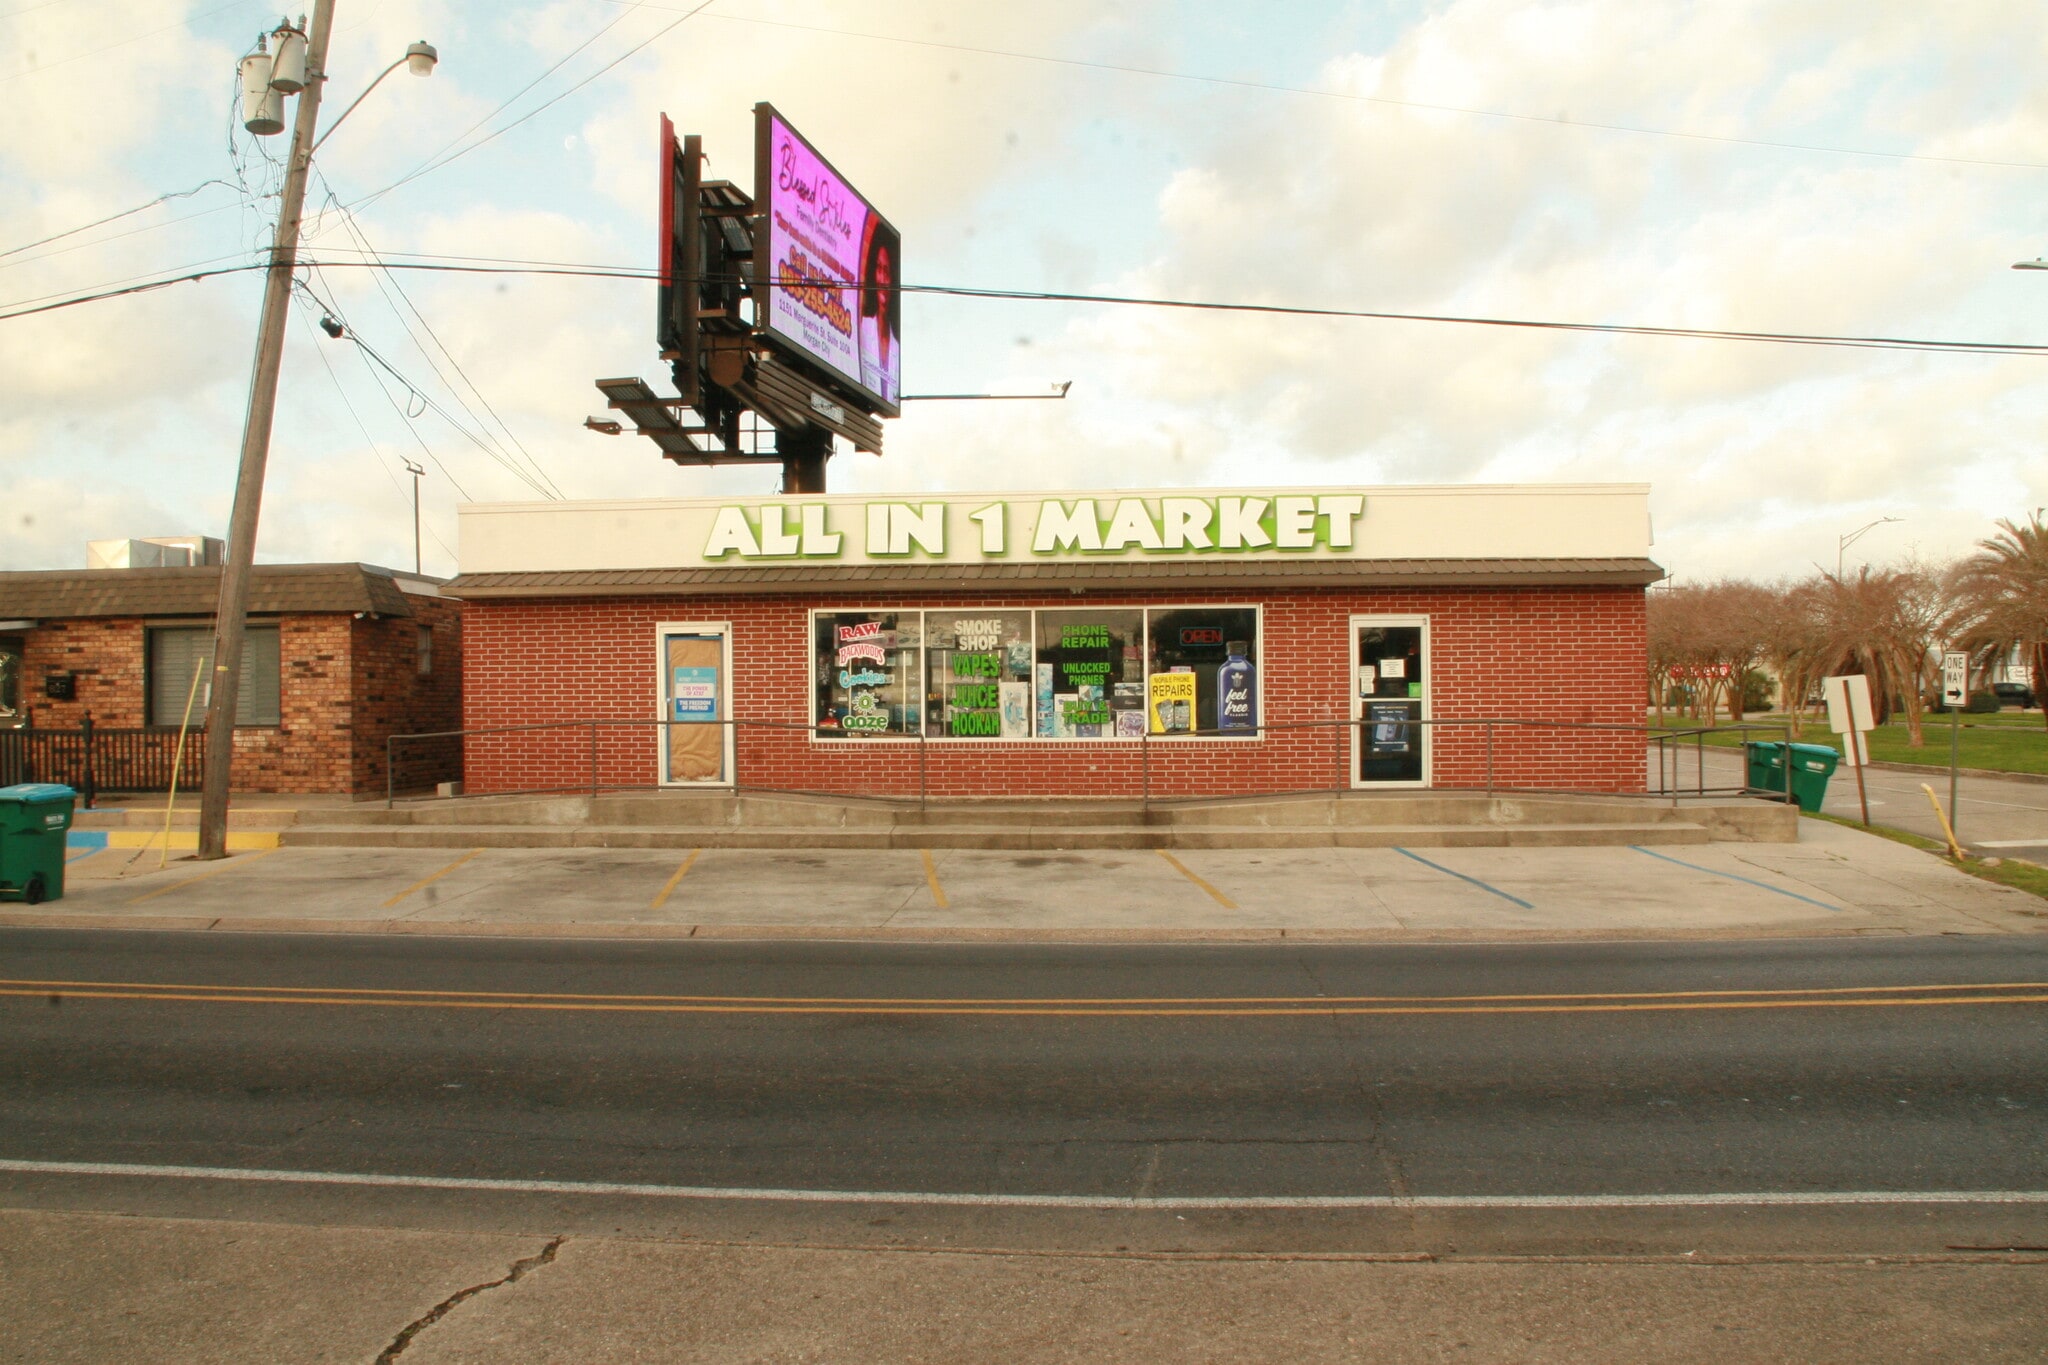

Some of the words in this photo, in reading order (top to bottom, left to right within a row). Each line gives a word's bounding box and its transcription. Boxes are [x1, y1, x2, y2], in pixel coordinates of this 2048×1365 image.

[790, 245, 807, 278] Call
[703, 504, 841, 558] ALL
[866, 502, 943, 555] IN
[969, 501, 1006, 555] 1
[1032, 495, 1364, 554] MARKET
[840, 622, 881, 640] RAW
[954, 620, 1002, 635] SMOKE
[1063, 625, 1108, 636] PHONE
[959, 635, 998, 651] SHOP
[1062, 637, 1109, 648] REPAIR
[1182, 629, 1222, 643] OPEN
[839, 644, 885, 666] BACKWOODS
[1946, 656, 1964, 669] ONE
[952, 653, 1000, 677] VAPES
[1063, 663, 1110, 673] UNLOCKED
[839, 668, 886, 689] Cookies
[1069, 675, 1105, 686] PHONES
[1946, 671, 1964, 684] WAY
[952, 684, 997, 708] JUICE
[1152, 684, 1193, 697] REPAIRS
[1225, 688, 1248, 704] feel
[1063, 700, 1095, 712] BUY
[1098, 701, 1108, 711] &
[1224, 701, 1248, 716] free
[952, 712, 1000, 735] HOOKAH
[1062, 713, 1109, 724] TRADE
